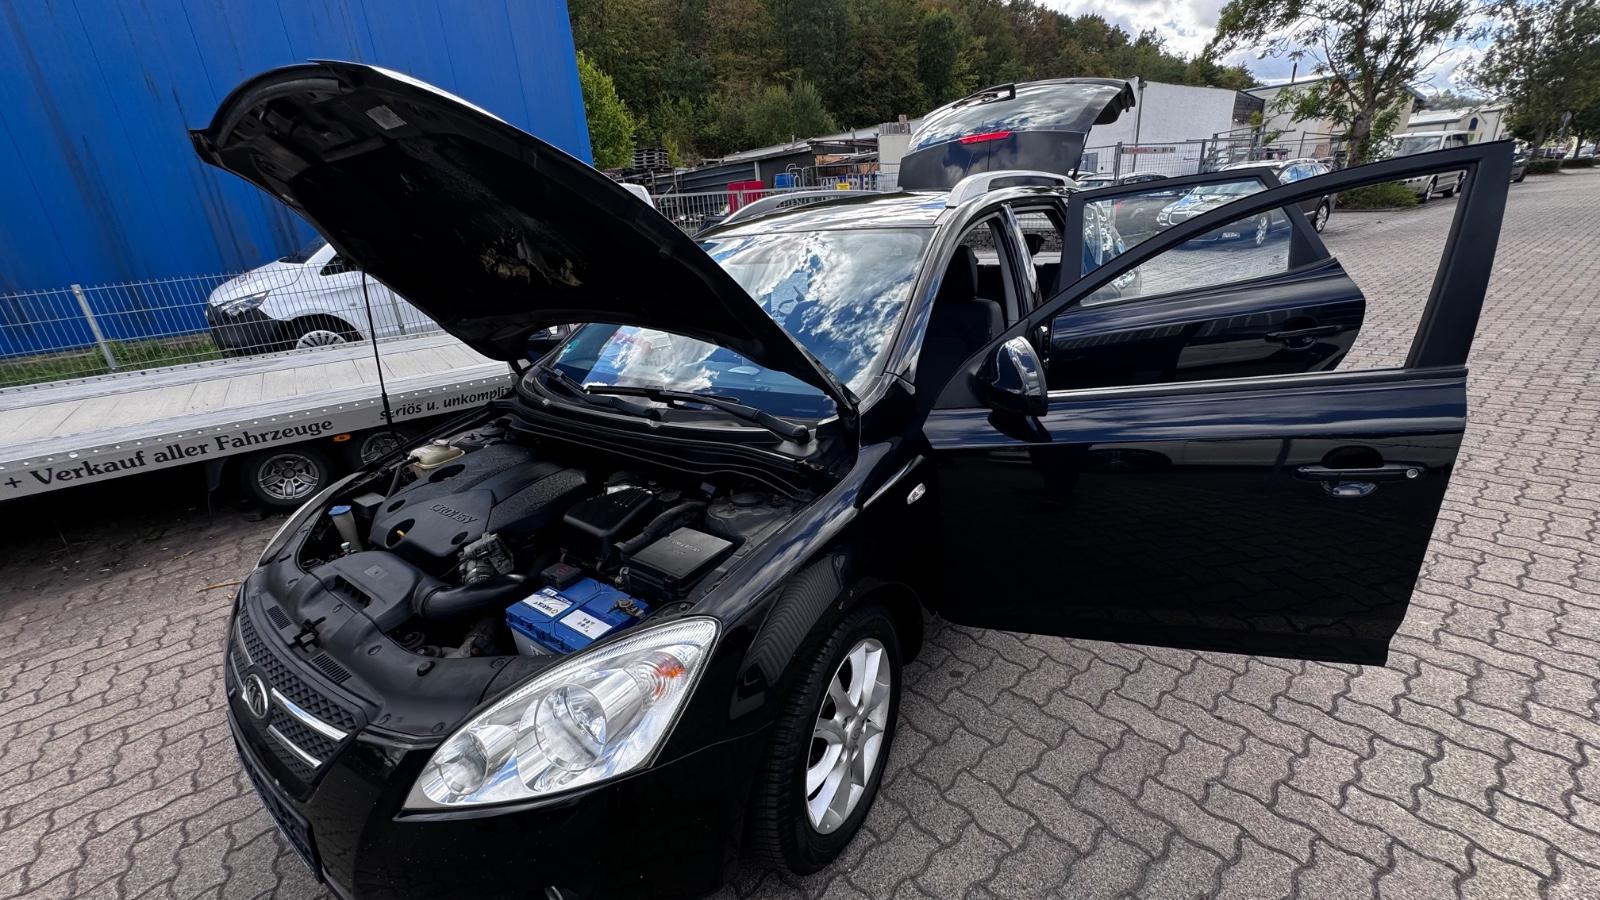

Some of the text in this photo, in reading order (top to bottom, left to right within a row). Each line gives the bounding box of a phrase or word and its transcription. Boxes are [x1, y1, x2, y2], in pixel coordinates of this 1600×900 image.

[426, 401, 440, 411] u.
[4, 419, 334, 489] + Verkauf aller Fahrzeuge
